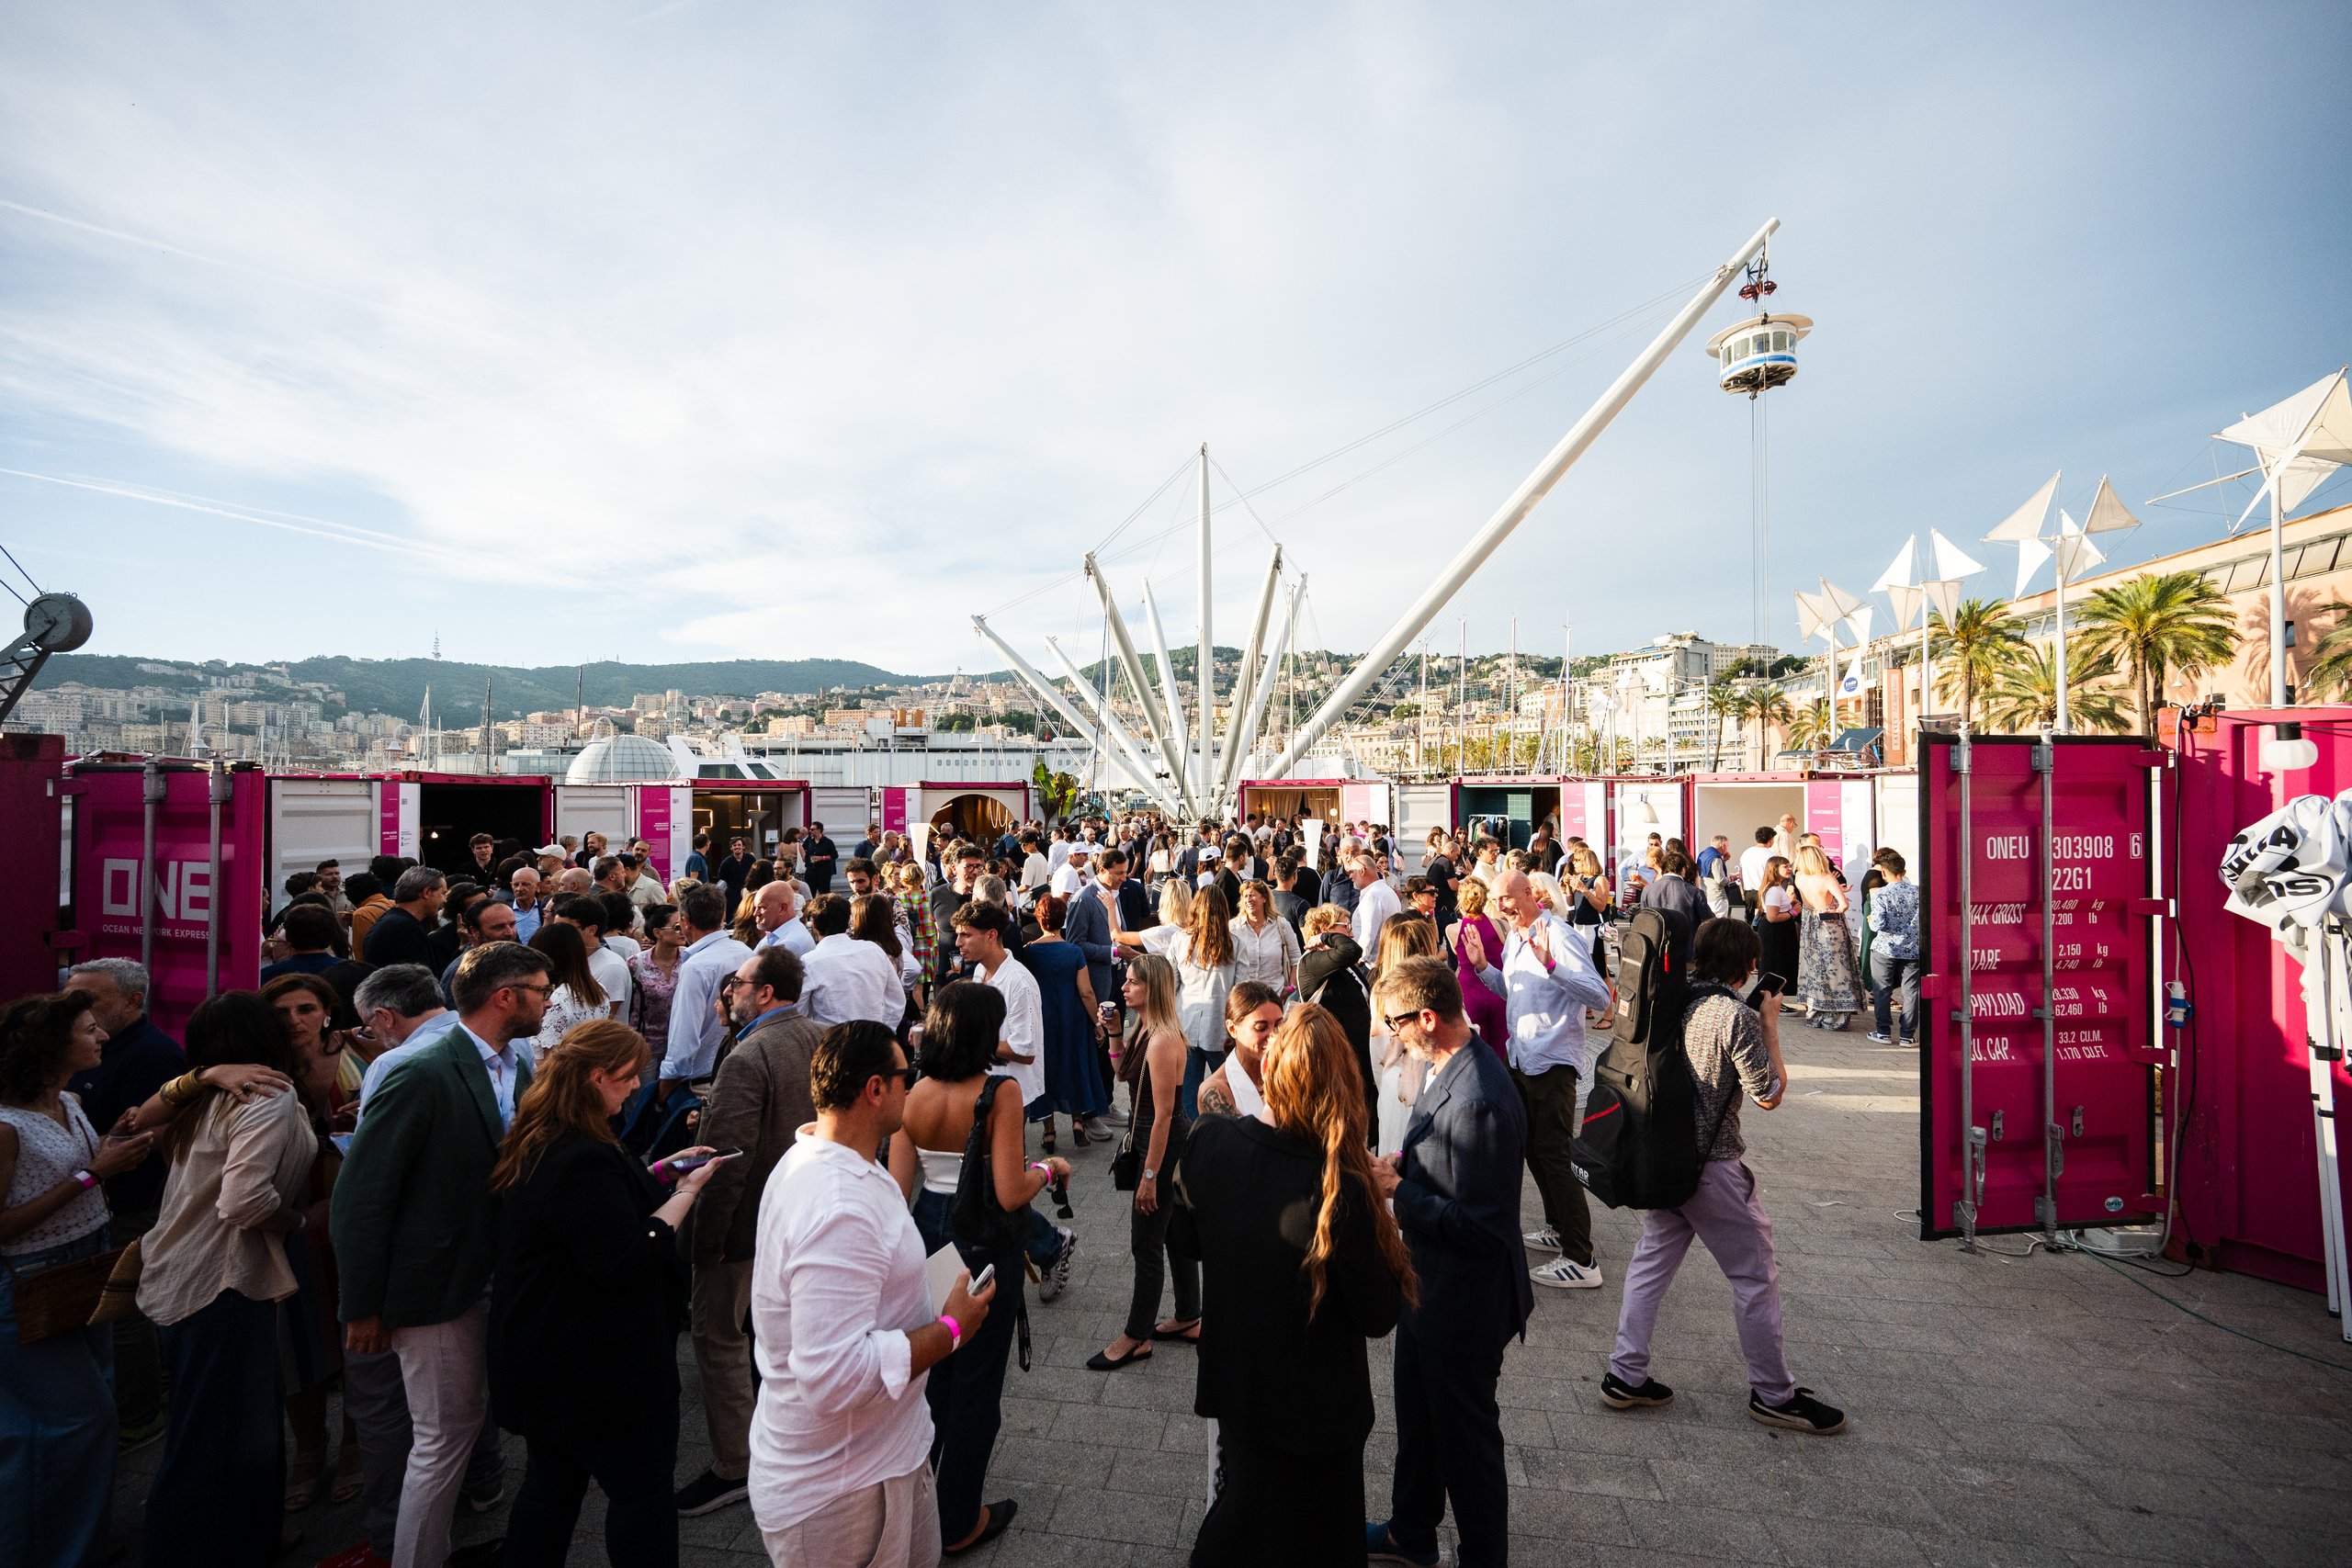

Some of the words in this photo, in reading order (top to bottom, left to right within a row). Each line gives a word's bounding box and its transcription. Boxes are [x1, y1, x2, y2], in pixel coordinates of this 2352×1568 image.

[1986, 836, 2030, 860] ONEU
[2052, 836, 2113, 860] 303908
[2131, 834, 2142, 857] 6
[2052, 867, 2092, 890] 22G1
[103, 858, 209, 921] ONE
[2091, 898, 2105, 911] kg
[1992, 903, 2027, 924] GROSS
[2088, 911, 2098, 924] lb
[102, 924, 130, 934] OCEAN
[132, 926, 172, 937] NEORK
[2058, 943, 2081, 956] 2.150
[2097, 942, 2109, 957] kg
[1971, 949, 2001, 971] TARE
[2054, 959, 2080, 970] 4.740
[2092, 958, 2104, 968] lb
[2090, 986, 2108, 1000] kg
[1970, 992, 2025, 1018] PAYLOAD
[2054, 1002, 2083, 1017] 62.460
[2098, 1001, 2108, 1014] lb
[2058, 1031, 2076, 1044] 33.2
[2079, 1029, 2103, 1043] CU.M.
[1986, 1036, 2016, 1061] CAP.
[2056, 1046, 2082, 1061] 1.170
[2082, 1045, 2109, 1059] CU.FT.
